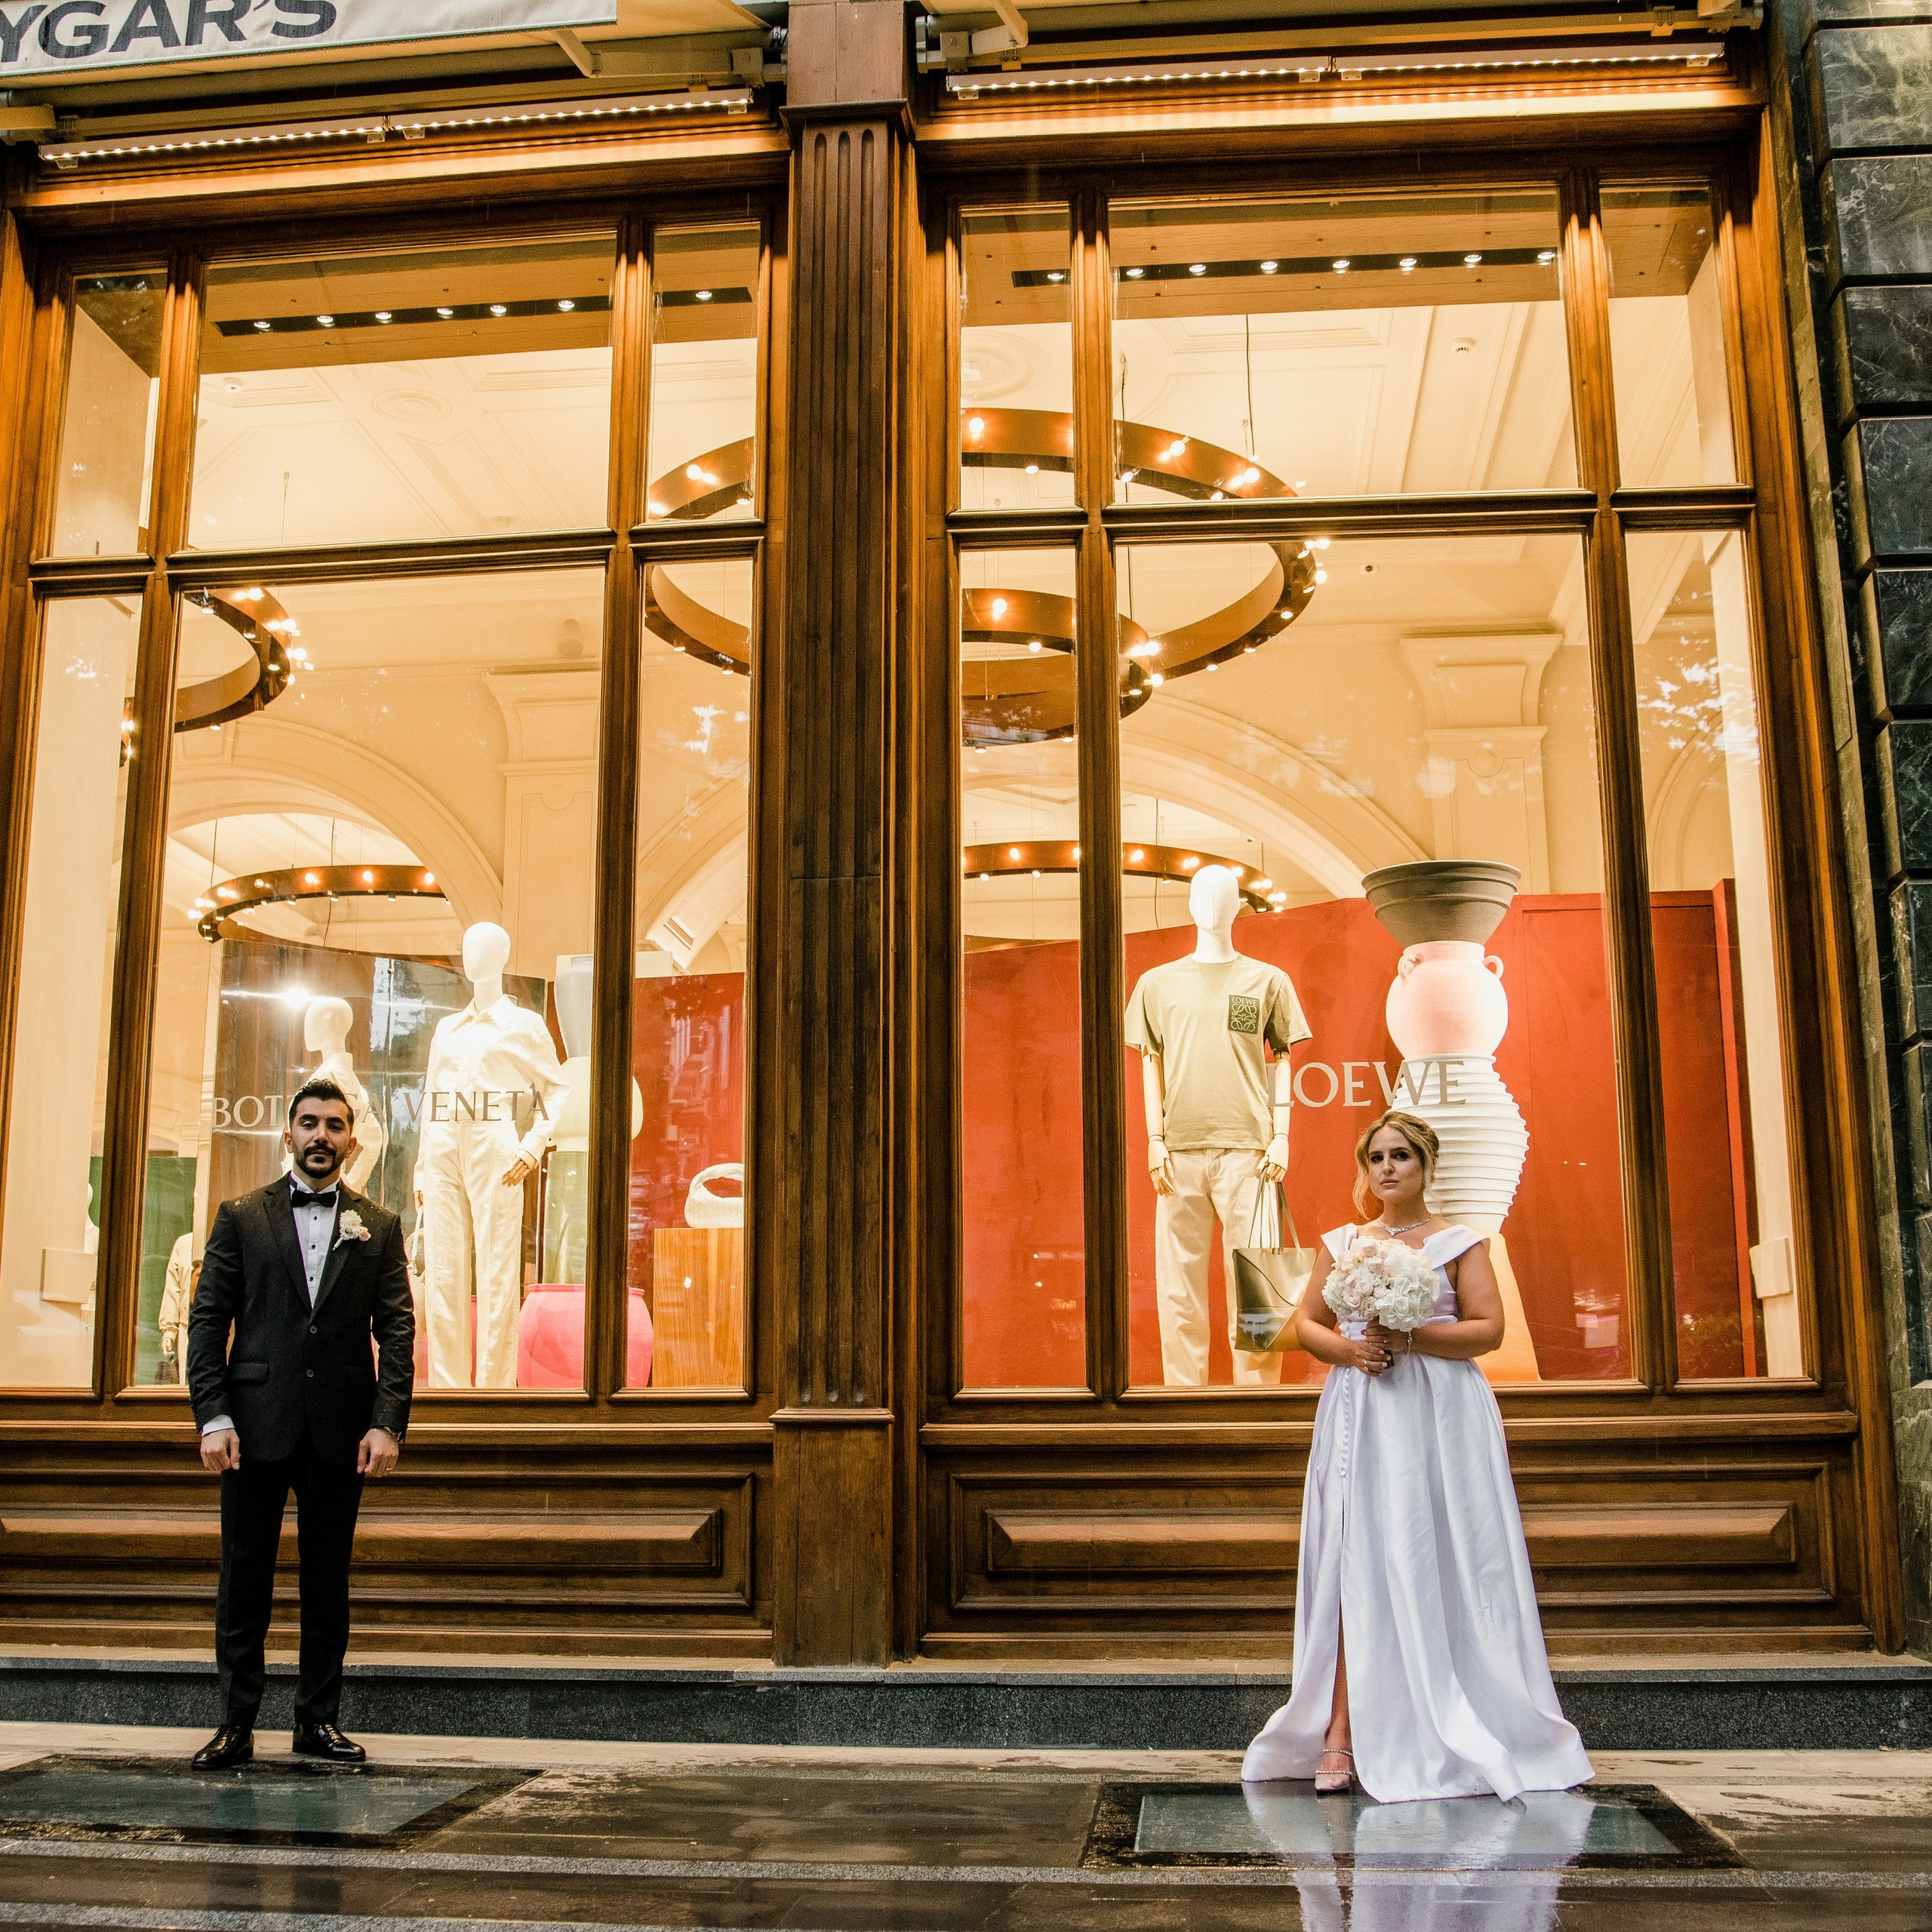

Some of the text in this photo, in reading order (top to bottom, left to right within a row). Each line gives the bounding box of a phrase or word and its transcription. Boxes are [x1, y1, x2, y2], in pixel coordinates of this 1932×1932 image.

[0, 0, 337, 63] YGAR'S
[1232, 996, 1257, 1006] LOEWE
[1266, 1060, 1466, 1107] LOEWE
[211, 1091, 550, 1128] BOTA VENETA
